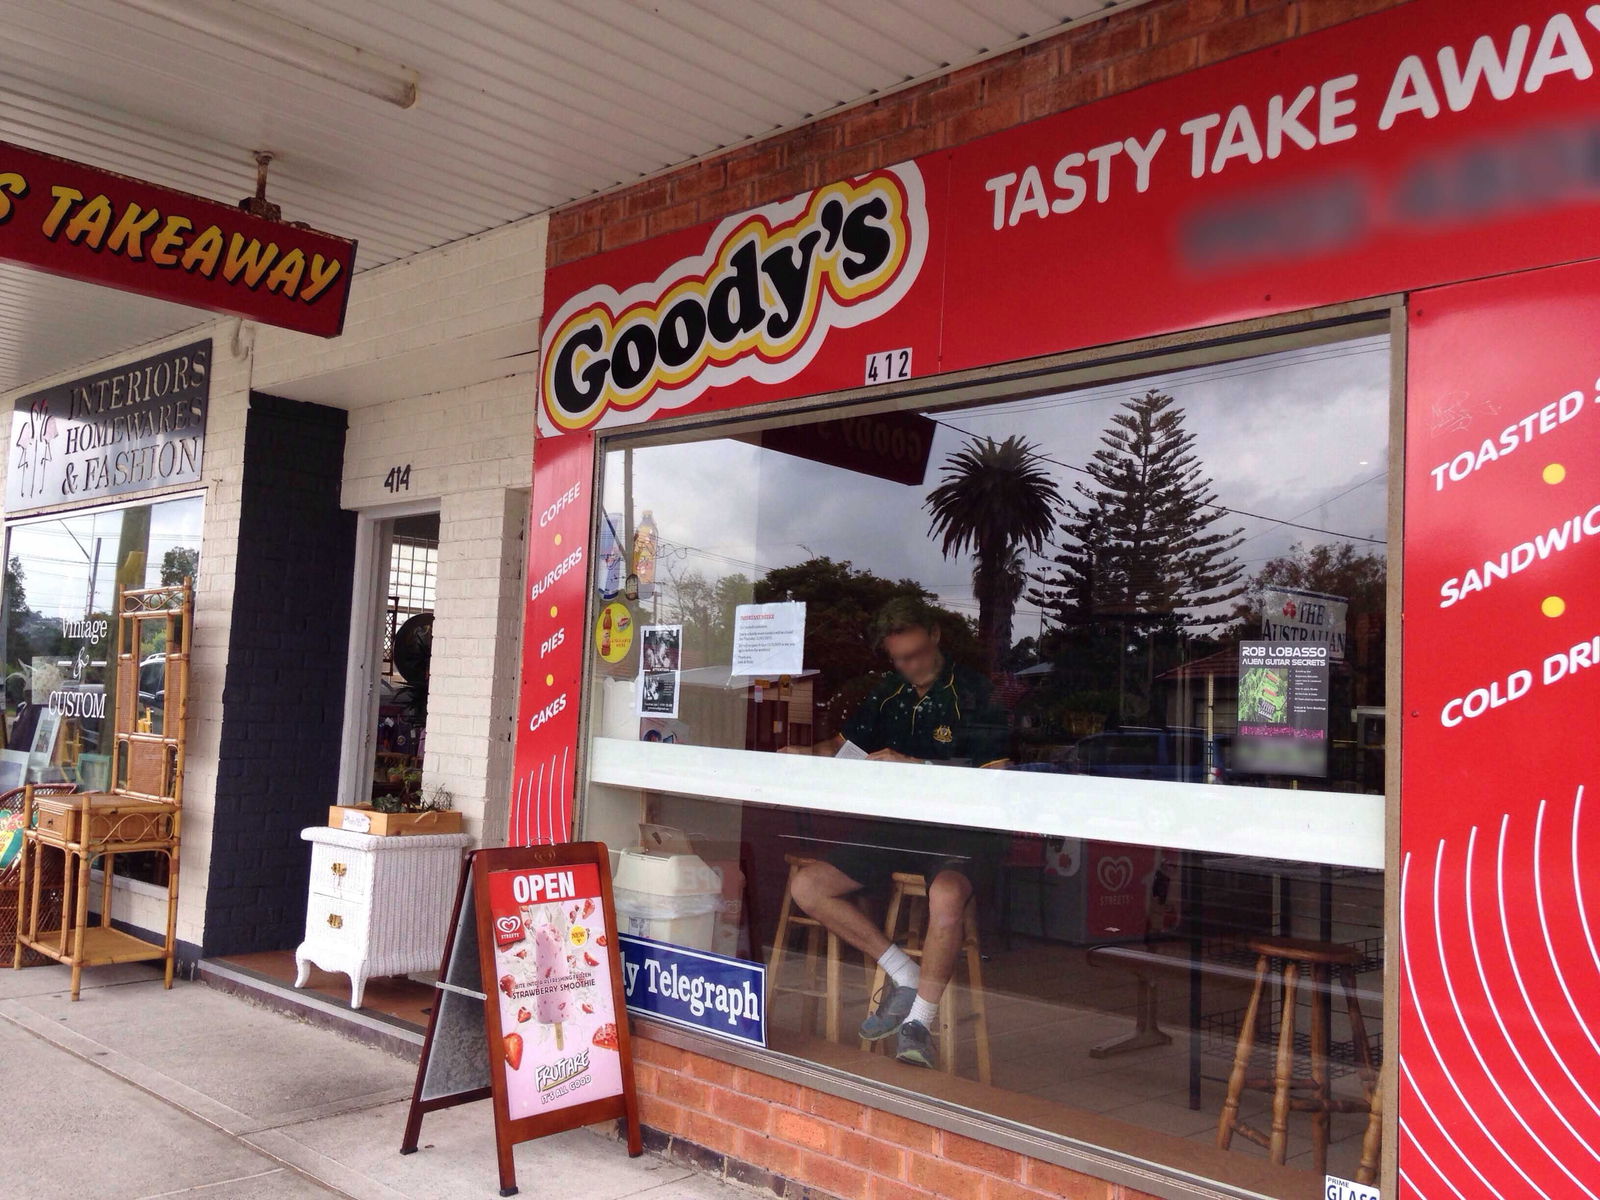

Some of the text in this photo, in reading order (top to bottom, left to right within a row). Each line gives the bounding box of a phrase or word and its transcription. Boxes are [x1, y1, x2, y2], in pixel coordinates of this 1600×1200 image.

[985, 129, 1166, 231] TASTY
[1180, 74, 1358, 178] TAKE
[1378, 4, 1600, 131] AWA
[42, 185, 341, 302] TAKEAWAY
[554, 197, 891, 413] Goody's
[868, 350, 909, 382] 412
[67, 350, 207, 421] INTERIORS
[64, 396, 202, 455] HOMEWARES
[1431, 390, 1584, 491] TOASTED
[384, 463, 411, 493] 414
[540, 481, 581, 527] COFFEE
[531, 547, 582, 600] BURGERS
[1440, 504, 1600, 608] SANDWIC
[62, 617, 108, 645] Vintage
[1300, 602, 1326, 626] THE
[540, 627, 565, 659] PIES
[1242, 646, 1327, 657] ROB LOBASSO
[1241, 658, 1326, 667] ALIEN GUITAR SECRETS
[1440, 635, 1600, 727] COLD DRI
[48, 691, 107, 719] CUSTOM
[529, 693, 566, 731] CAKES
[513, 871, 576, 904] OPEN
[512, 978, 596, 999] STRAWBERRY SMOOTHIE
[644, 958, 760, 1026] Telegraph
[535, 1048, 591, 1092] FRUTTARE
[556, 1085, 569, 1098] ALL
[570, 1075, 592, 1090] GOOD
[1327, 1177, 1350, 1188] PRIME
